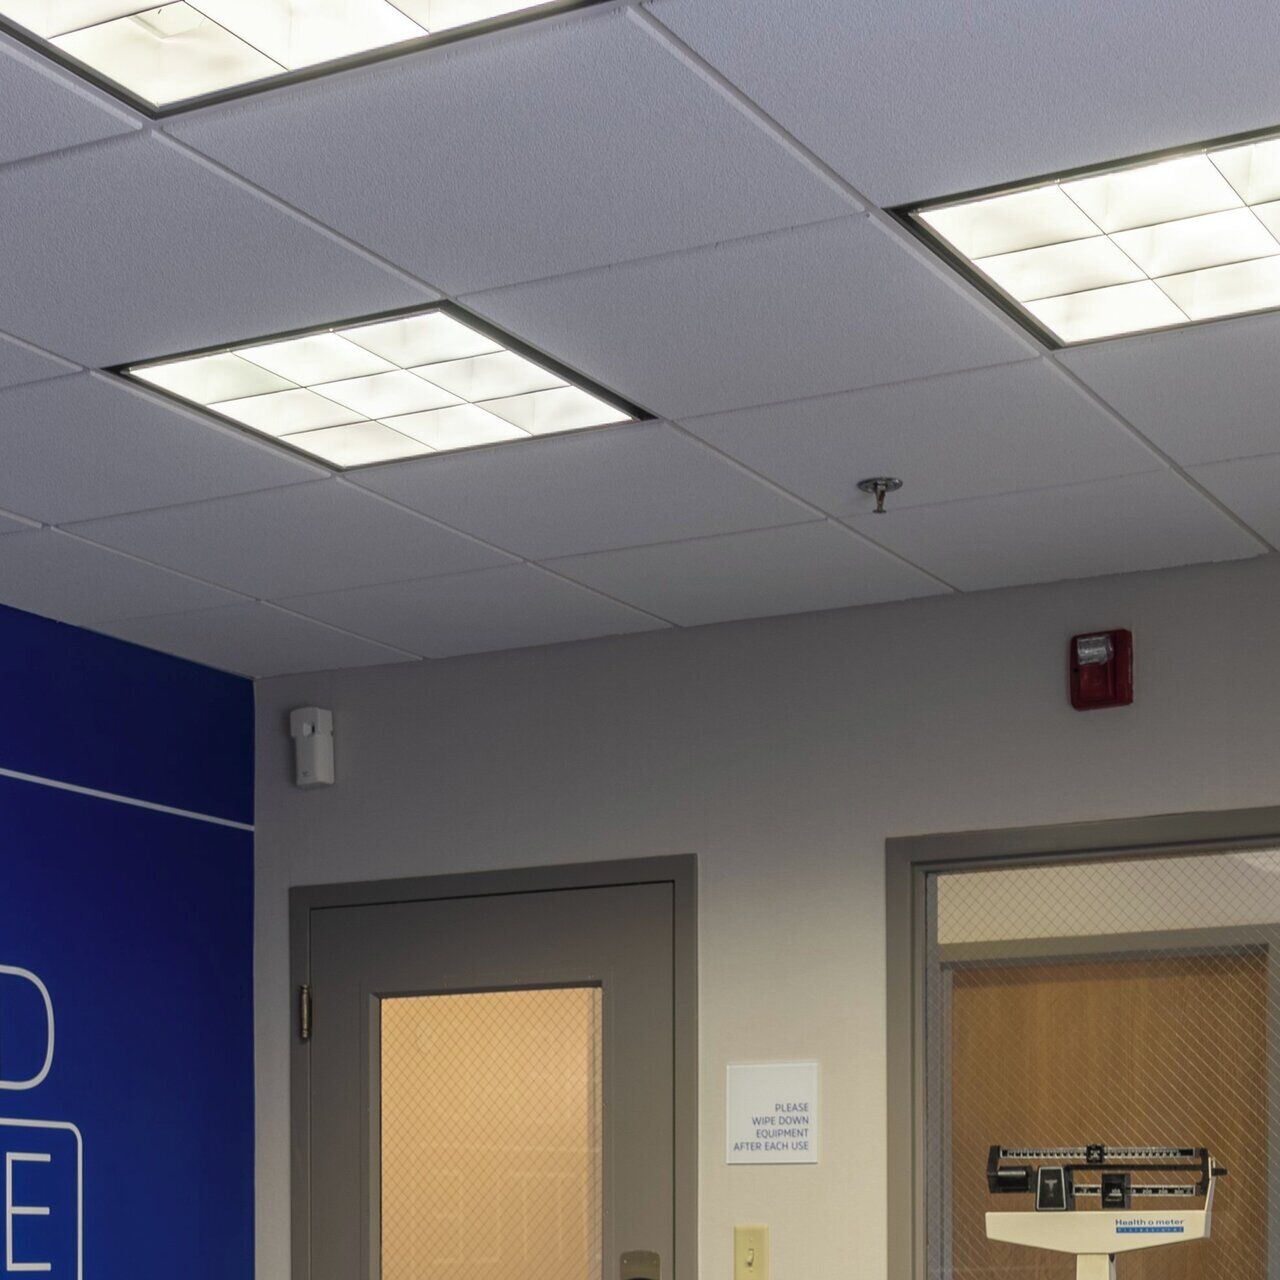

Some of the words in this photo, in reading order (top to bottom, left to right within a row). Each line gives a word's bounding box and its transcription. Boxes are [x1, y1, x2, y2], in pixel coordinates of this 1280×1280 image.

[775, 1103, 809, 1112] PLEASE
[752, 1116, 776, 1126] WIPE
[778, 1115, 809, 1125] DOWN
[756, 1128, 809, 1139] EQUIPMENT
[733, 1142, 761, 1151] AFTER
[765, 1141, 788, 1151] EACH
[791, 1141, 809, 1150] USE
